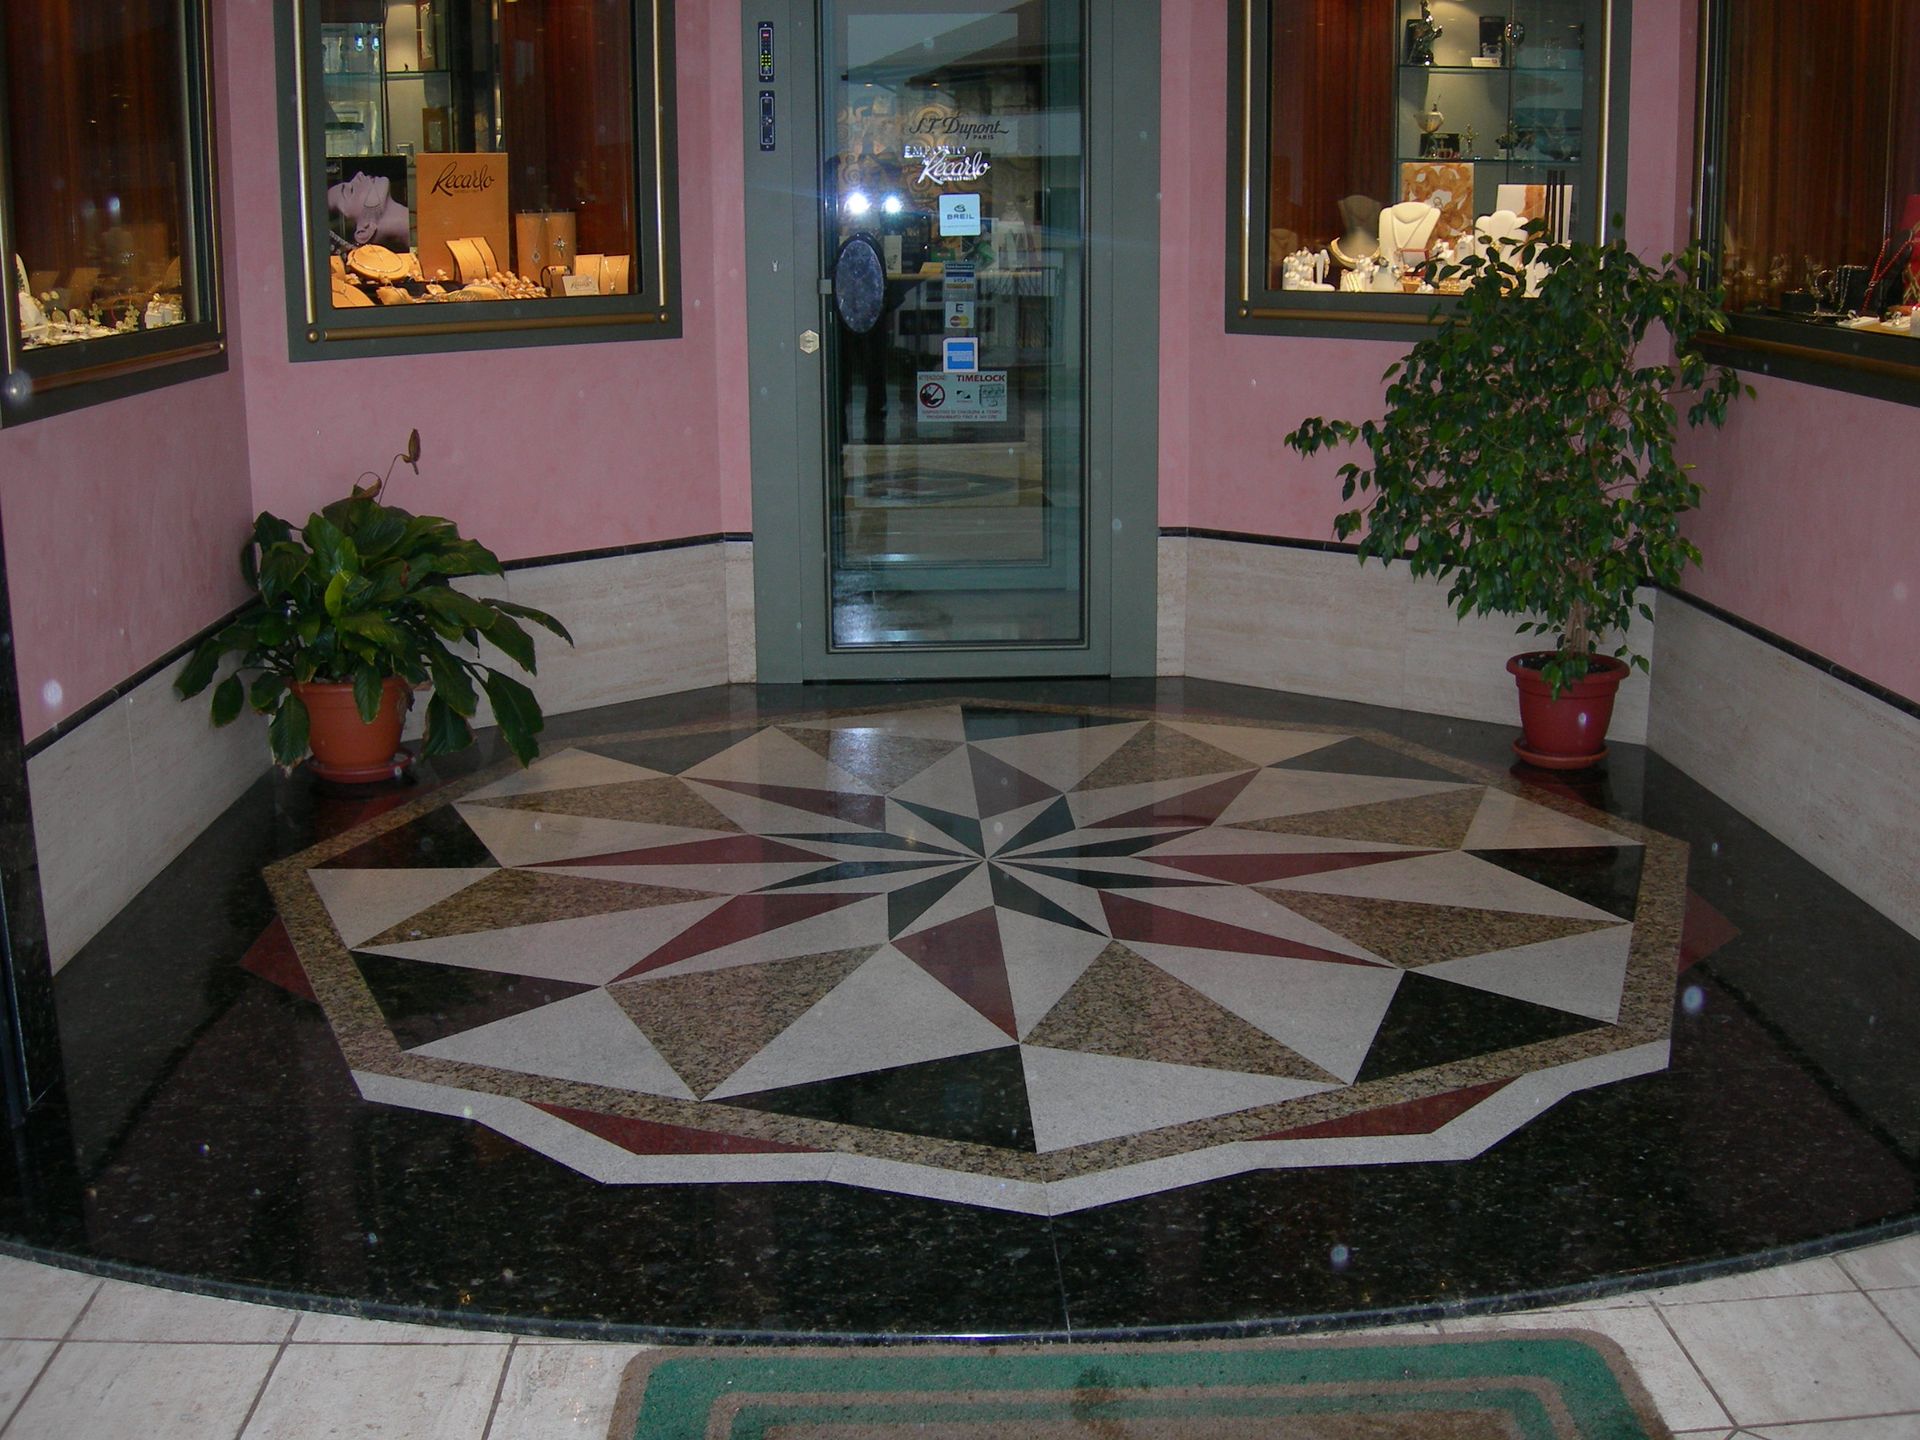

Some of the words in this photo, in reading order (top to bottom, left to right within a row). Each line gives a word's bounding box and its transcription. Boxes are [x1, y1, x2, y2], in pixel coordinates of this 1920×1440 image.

[943, 115, 1009, 140] Dupont
[431, 161, 496, 197] Recarlo
[917, 150, 992, 186] Recarlo
[946, 213, 976, 221] BREIL
[956, 374, 1006, 383] TIMELOCK
